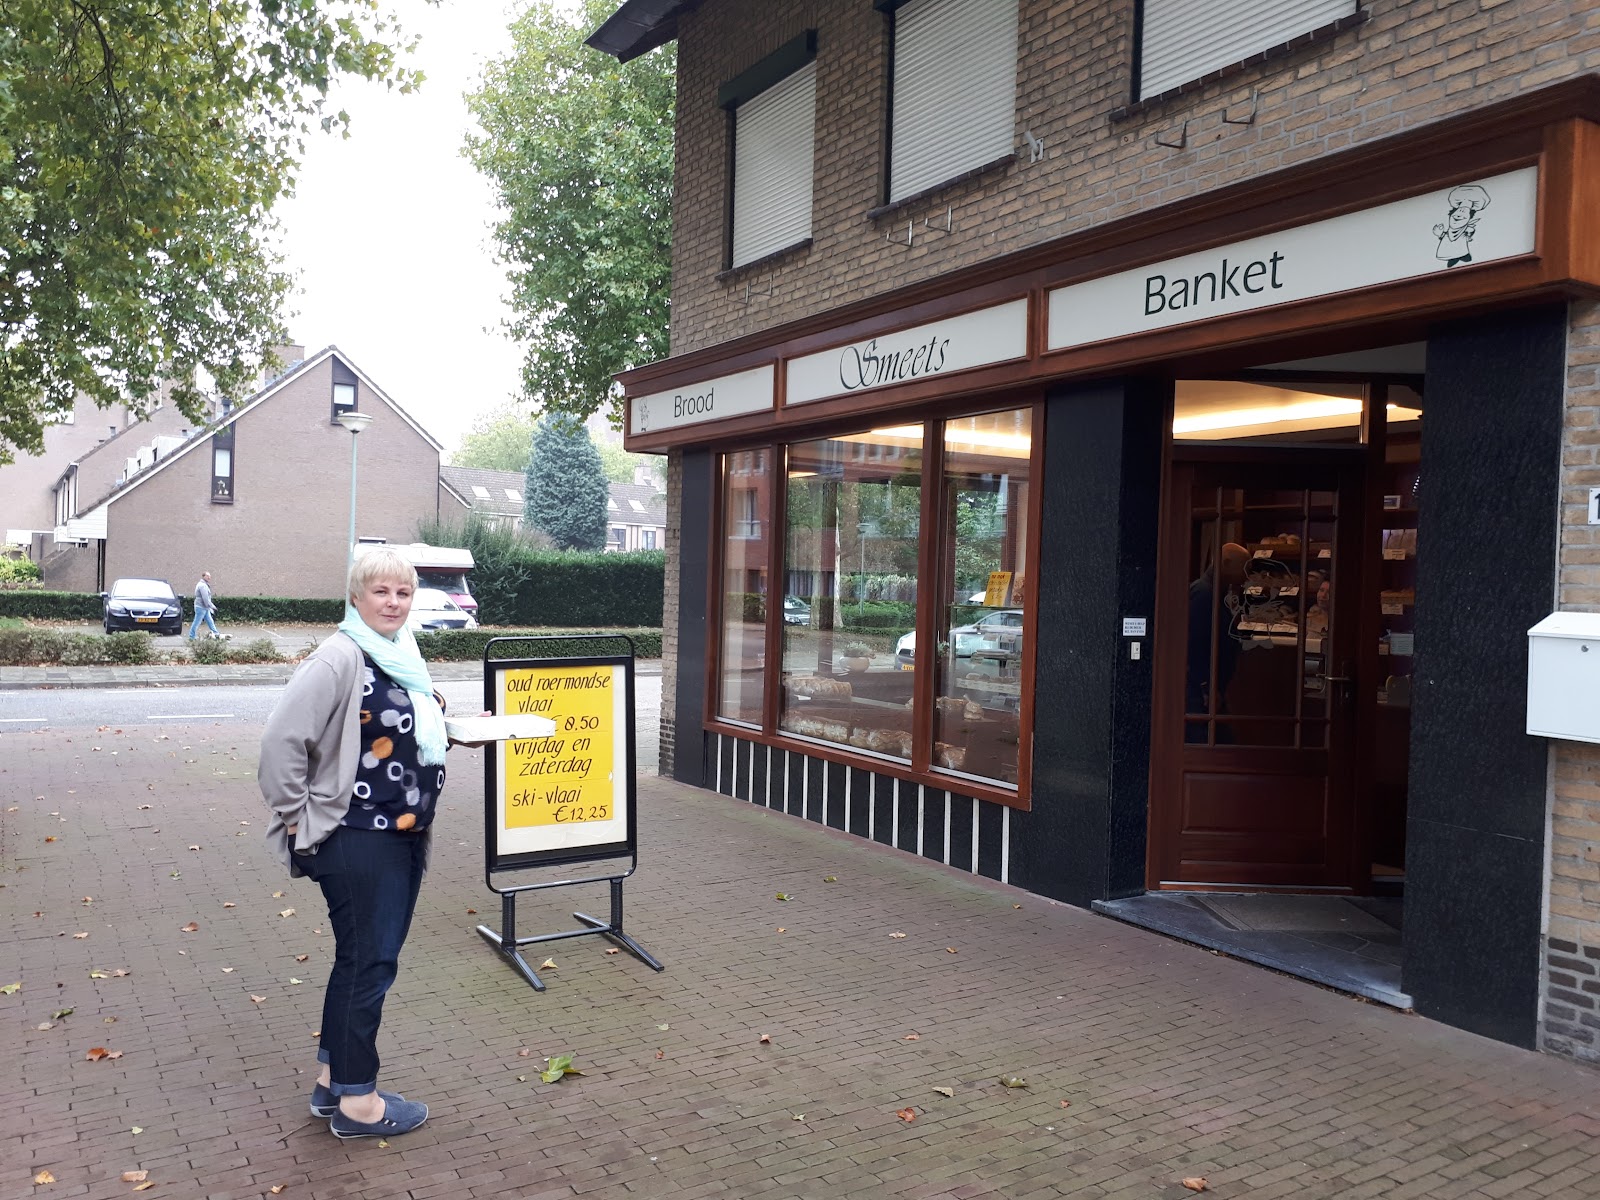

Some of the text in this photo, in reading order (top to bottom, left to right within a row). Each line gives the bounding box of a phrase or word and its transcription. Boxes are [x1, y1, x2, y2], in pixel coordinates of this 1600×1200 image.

[1144, 250, 1285, 316] Banket
[839, 337, 950, 391] Smeets
[673, 387, 715, 418] Brood
[507, 672, 611, 693] oud roermondse
[518, 694, 555, 713] vlaai
[513, 737, 591, 760] vrijdag en
[519, 756, 593, 779] zaterdag
[512, 785, 583, 807] ski-vlaai
